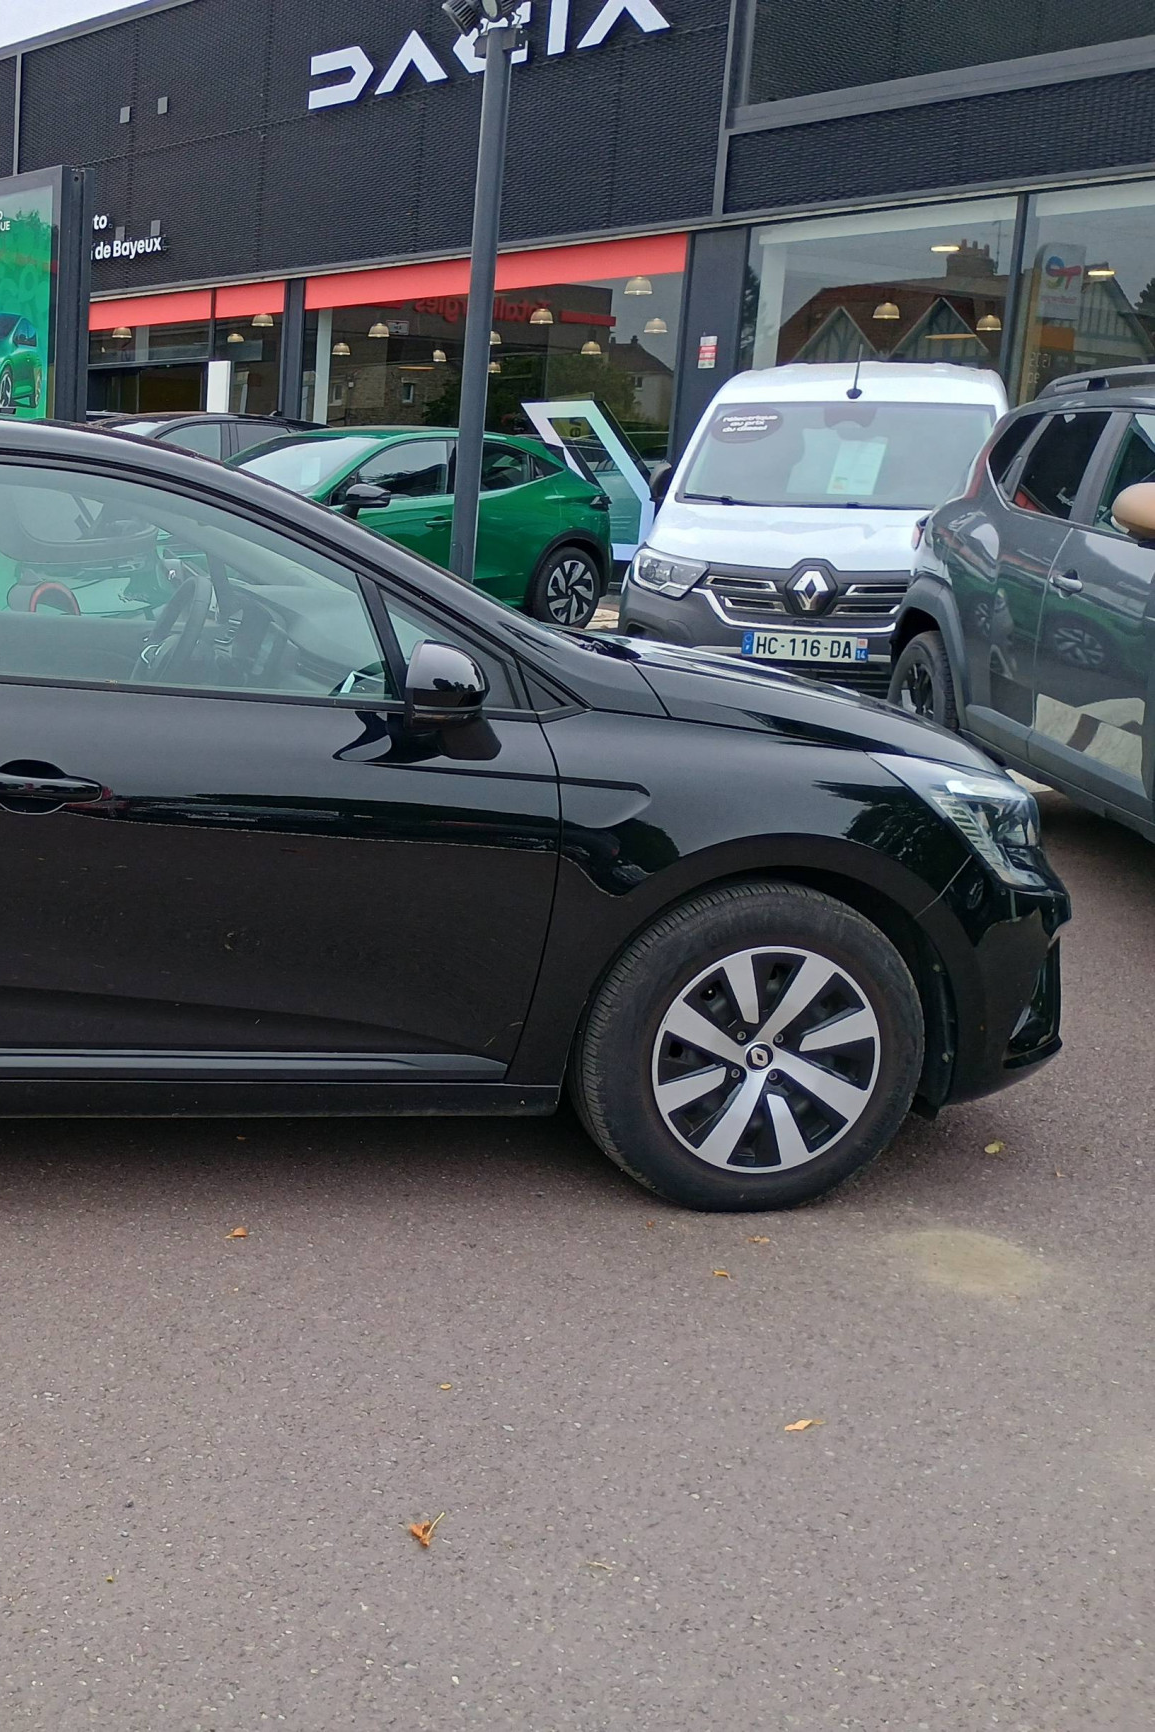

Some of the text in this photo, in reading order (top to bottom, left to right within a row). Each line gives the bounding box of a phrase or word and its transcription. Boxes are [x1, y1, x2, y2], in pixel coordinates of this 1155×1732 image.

[95, 241, 111, 260] de
[113, 237, 161, 260] Bayeux
[755, 636, 852, 659] HC-116-DA
